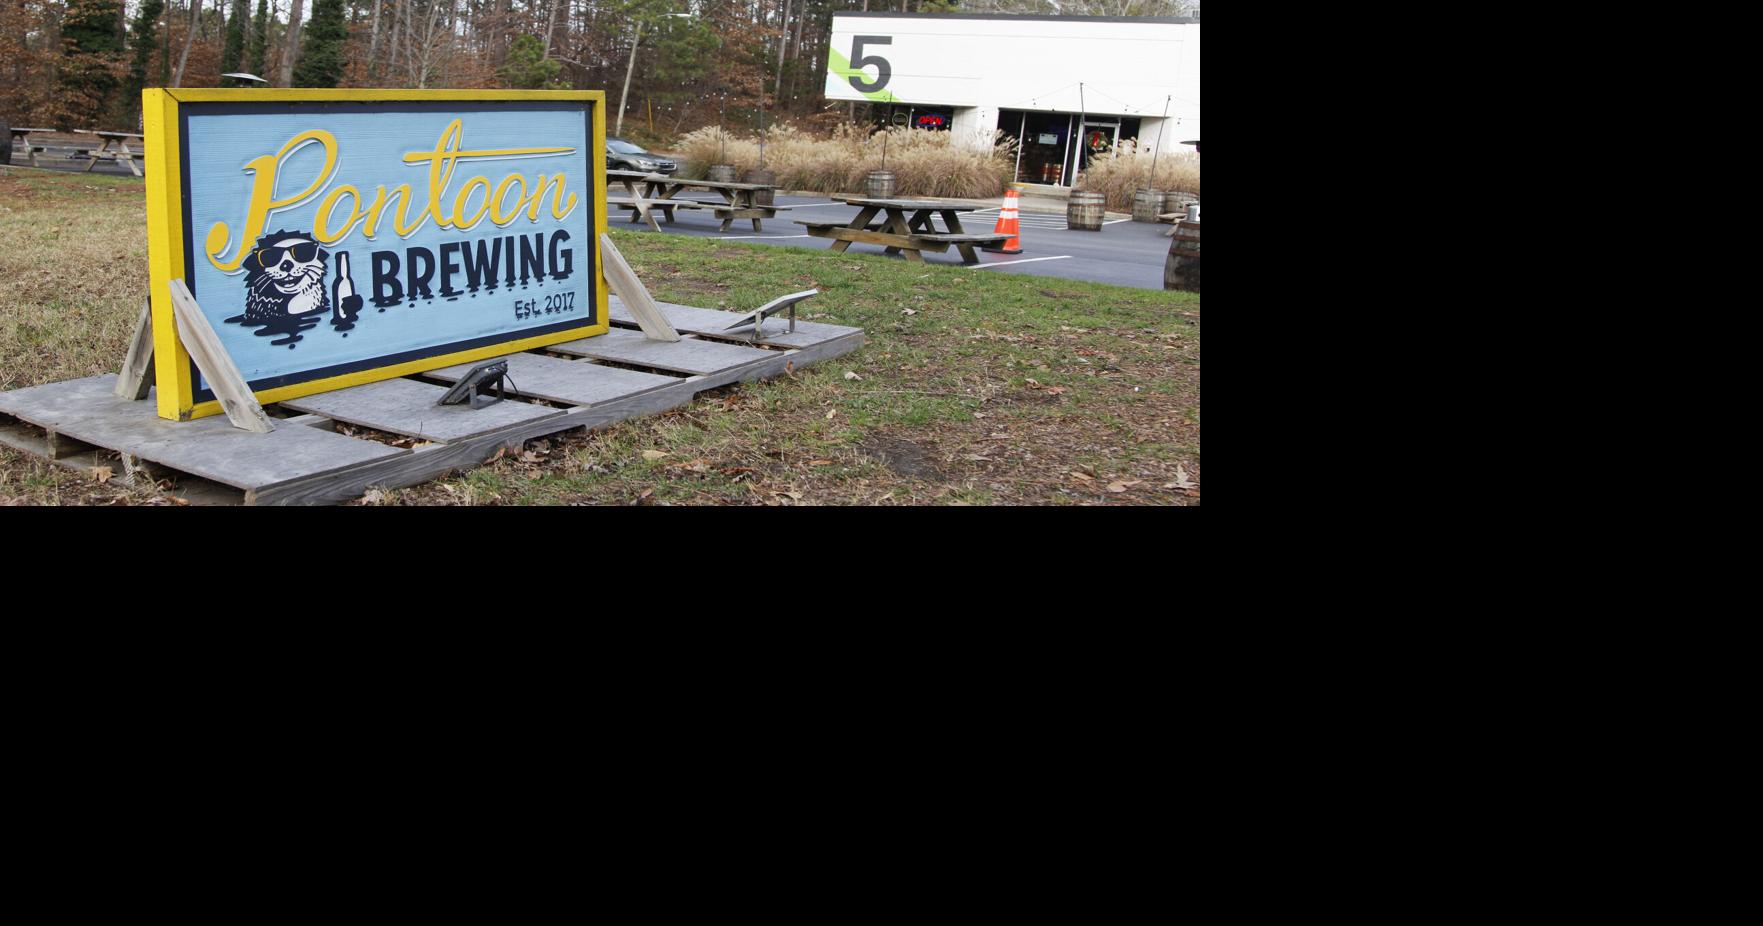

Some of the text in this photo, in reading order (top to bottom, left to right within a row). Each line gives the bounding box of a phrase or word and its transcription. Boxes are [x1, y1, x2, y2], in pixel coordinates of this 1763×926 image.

[848, 35, 893, 93] 5
[205, 118, 578, 274] Pontoon
[370, 229, 573, 308] BREWING
[515, 292, 575, 318] Est. 2017
